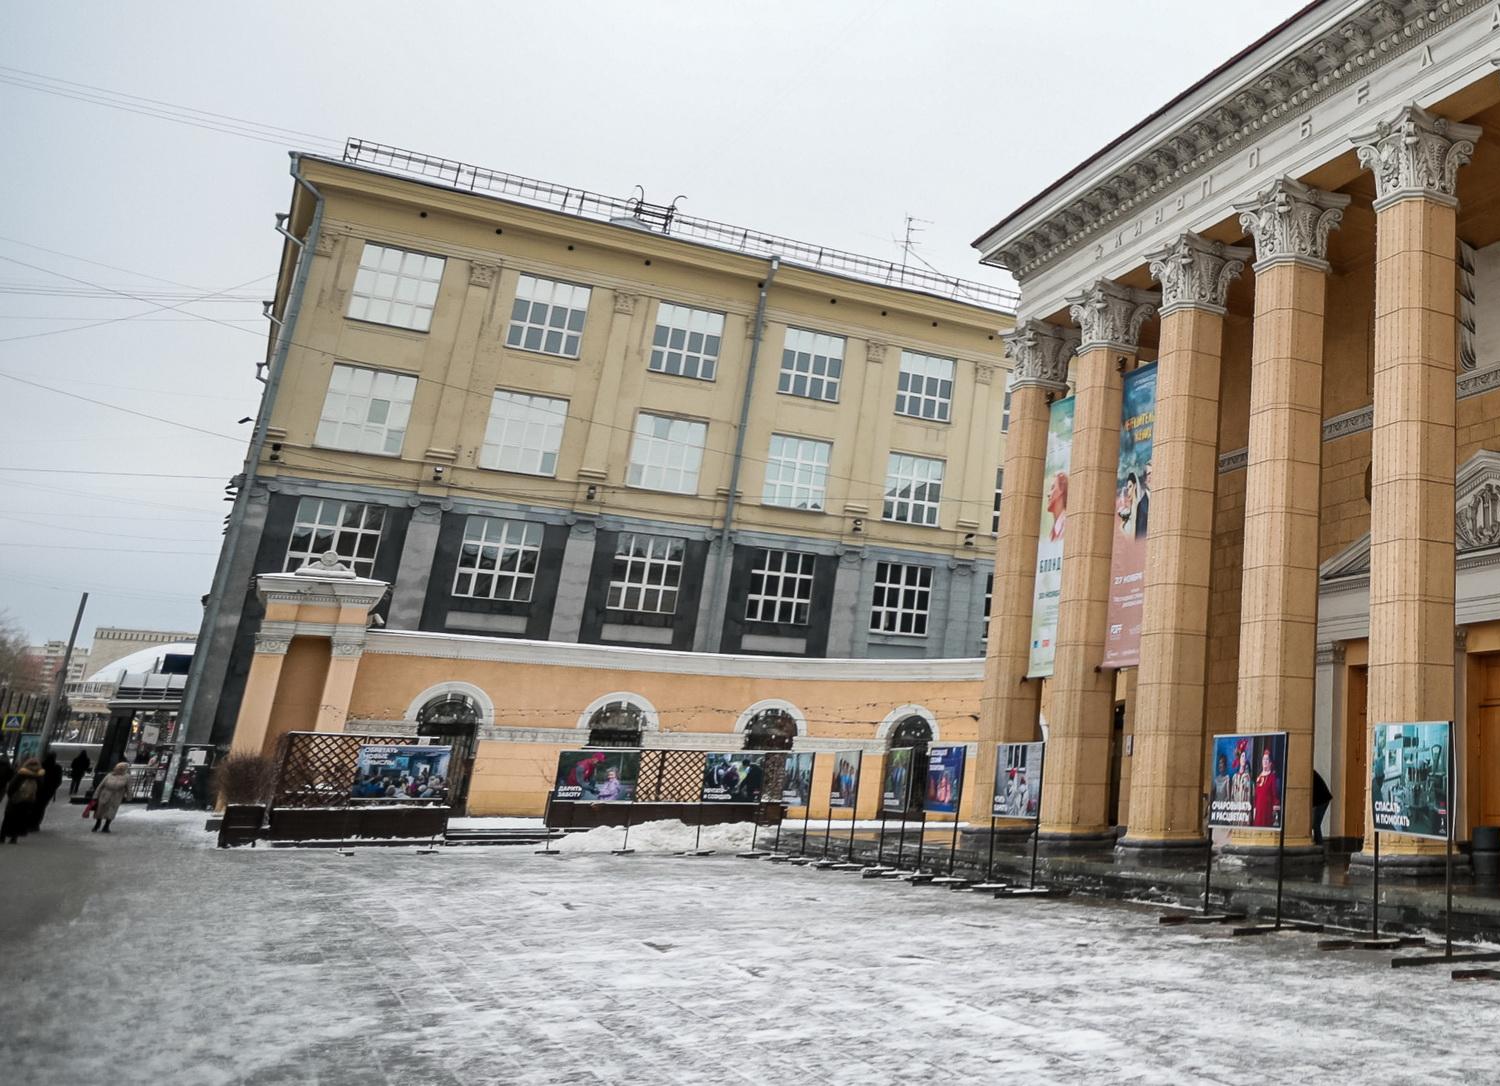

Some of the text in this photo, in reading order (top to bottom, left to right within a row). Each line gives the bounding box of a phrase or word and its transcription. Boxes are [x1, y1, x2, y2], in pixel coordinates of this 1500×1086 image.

[1211, 800, 1252, 812] ОЧАРОВЫВАТЬ
[1374, 800, 1401, 813] СПАСАТЬ
[1211, 810, 1250, 823] И РАСЦВЕТАТЬ
[1375, 813, 1410, 828] И ПОМОГАТЬ
